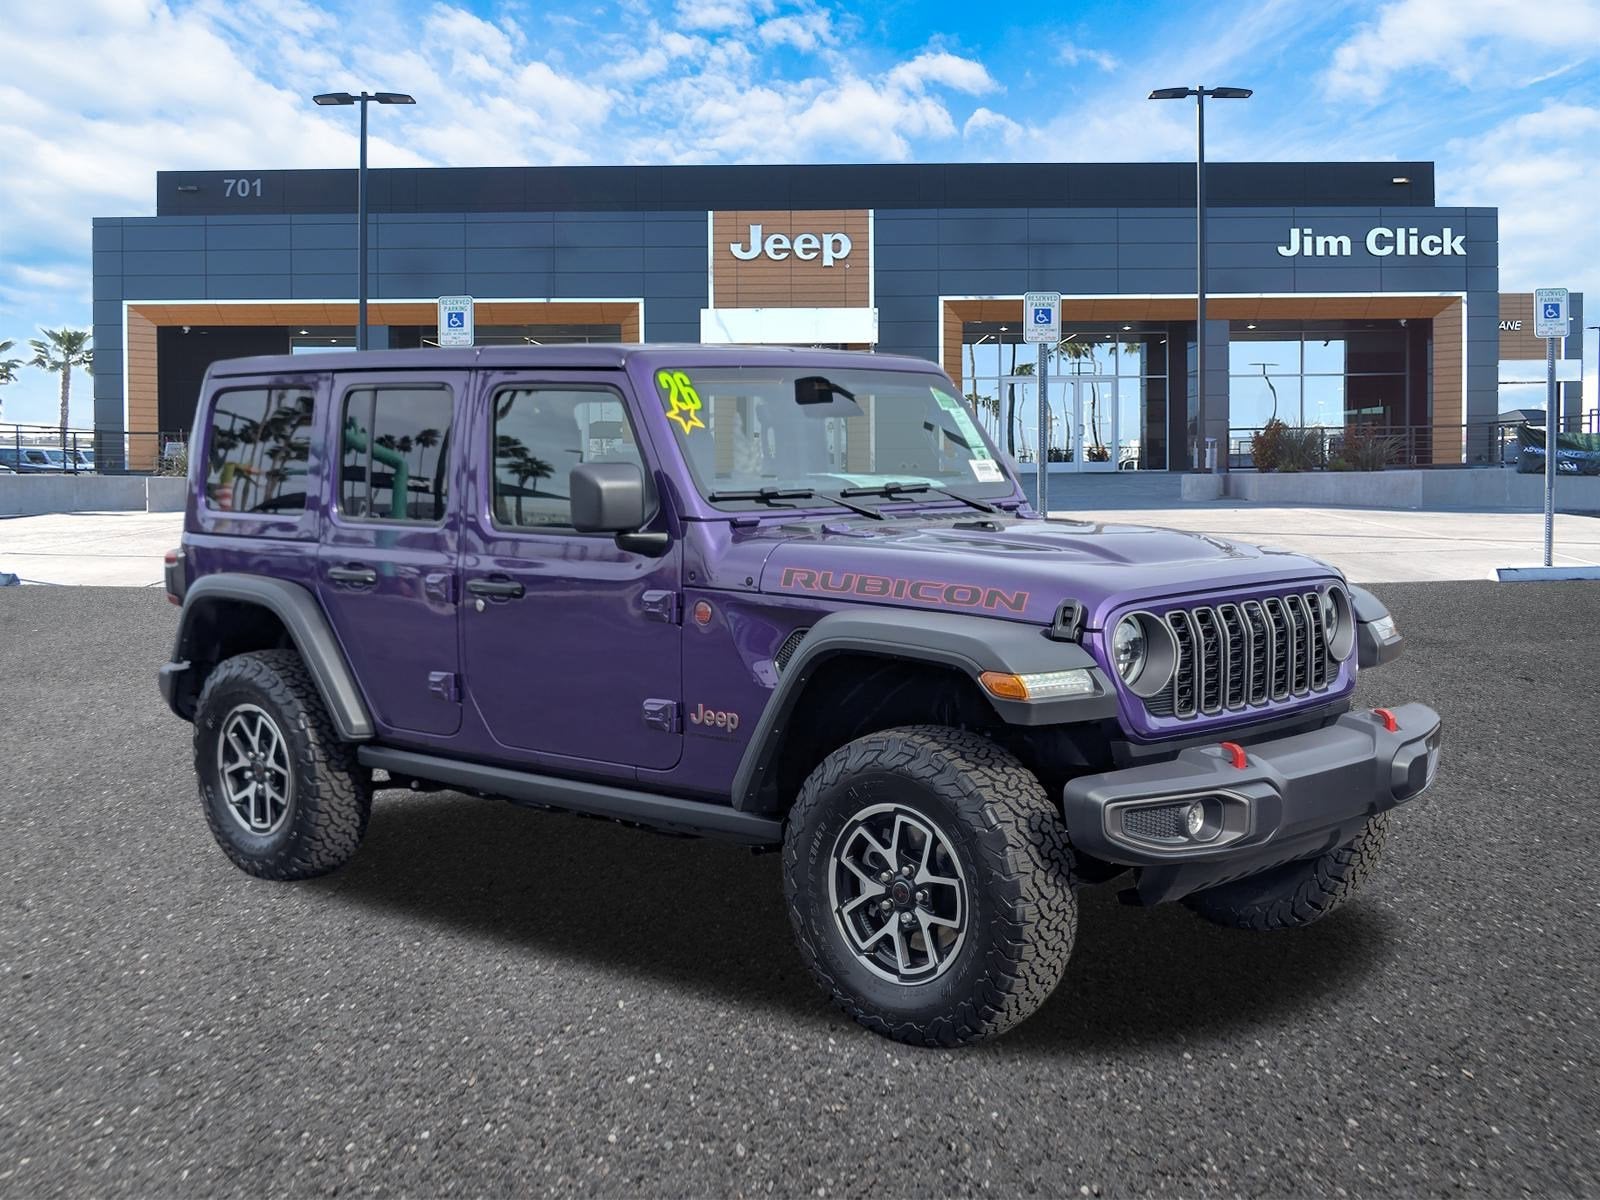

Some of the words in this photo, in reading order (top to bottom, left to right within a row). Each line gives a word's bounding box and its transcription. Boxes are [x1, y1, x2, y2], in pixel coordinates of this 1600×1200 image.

[223, 178, 262, 197] 701
[729, 223, 852, 267] Jeep
[1277, 228, 1352, 256] Jim
[1365, 227, 1467, 256] Click
[658, 371, 702, 411] 26
[780, 567, 1030, 613] RUBICON
[690, 703, 739, 733] Jeep
